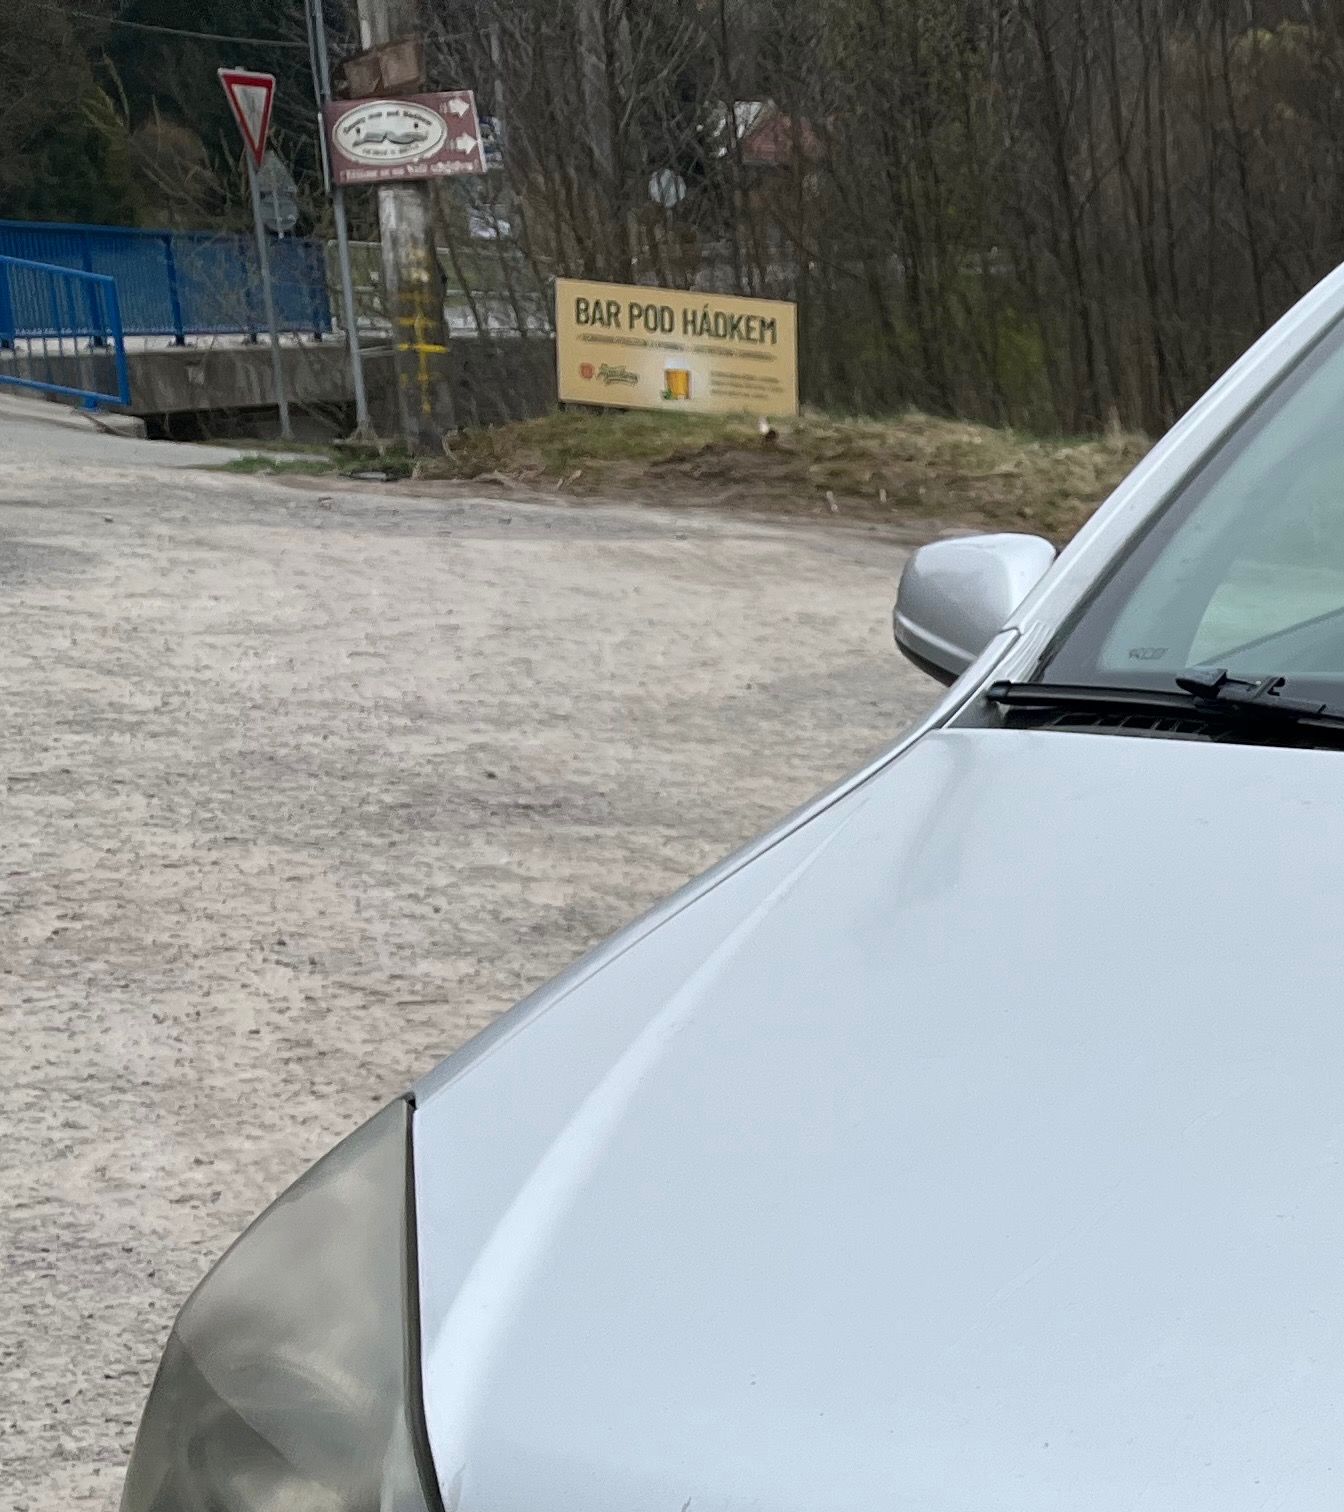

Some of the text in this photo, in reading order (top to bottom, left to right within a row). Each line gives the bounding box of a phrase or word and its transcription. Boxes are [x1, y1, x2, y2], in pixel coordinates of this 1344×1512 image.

[575, 297, 777, 345] BAR POD HÁDKEM
